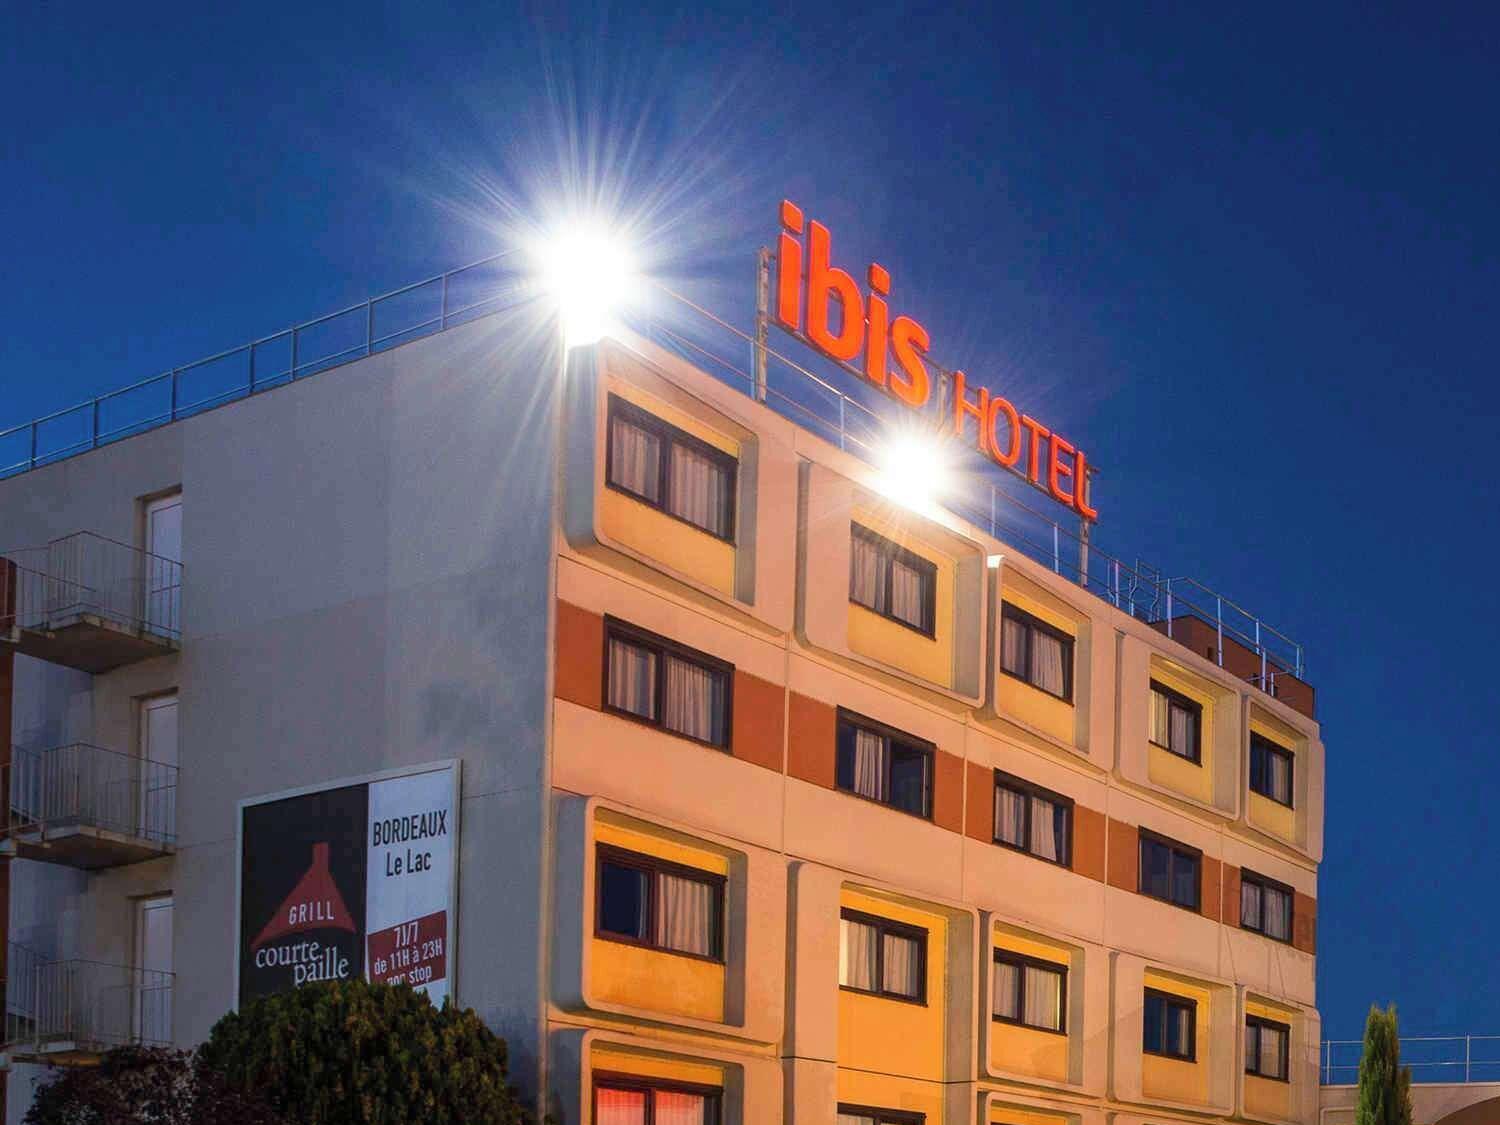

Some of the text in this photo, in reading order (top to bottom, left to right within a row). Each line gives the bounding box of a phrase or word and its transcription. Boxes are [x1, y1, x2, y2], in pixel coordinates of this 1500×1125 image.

[778, 199, 1098, 520] ibis HOTEL
[373, 809, 447, 847] BORDEAUX
[386, 848, 432, 877] Le Lac
[288, 901, 334, 925] GRILL
[255, 941, 321, 968] courte
[294, 946, 349, 990] paille
[374, 937, 443, 975] de 11H à 23H
[409, 966, 432, 984] stop
